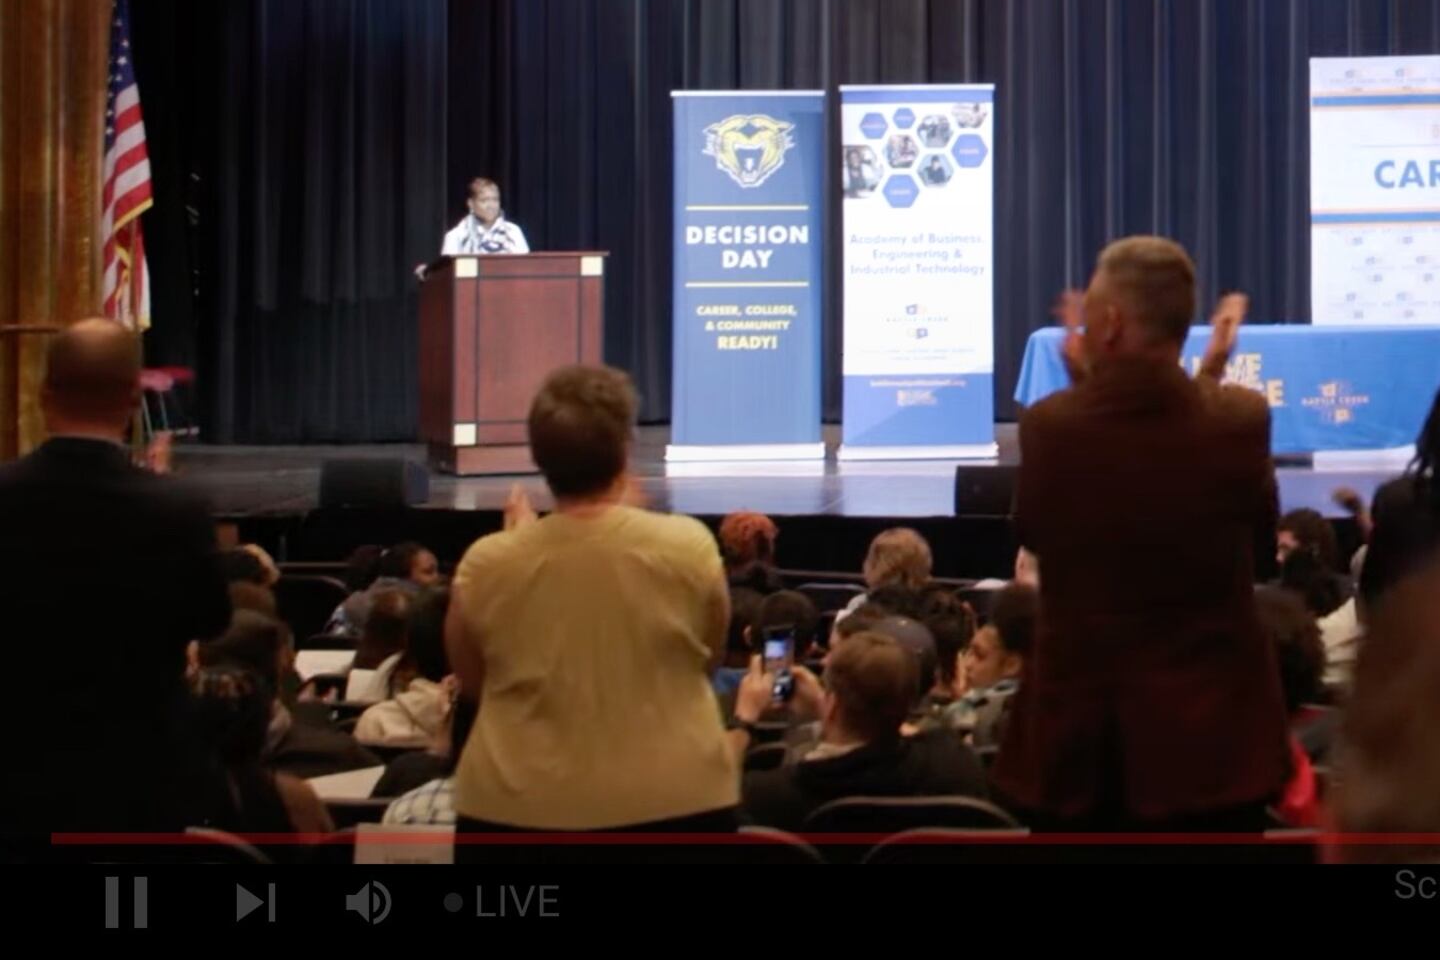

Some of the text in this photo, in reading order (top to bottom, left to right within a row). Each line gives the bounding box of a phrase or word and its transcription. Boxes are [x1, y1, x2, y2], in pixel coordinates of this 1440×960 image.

[685, 224, 810, 245] DECISION
[850, 233, 907, 246] Academy
[912, 232, 924, 244] of
[722, 249, 774, 269] DAY
[872, 248, 963, 261] Engineering &
[850, 263, 986, 276] Industrial Technology
[705, 319, 790, 331] & COMMUNITY
[717, 335, 778, 350] READY!
